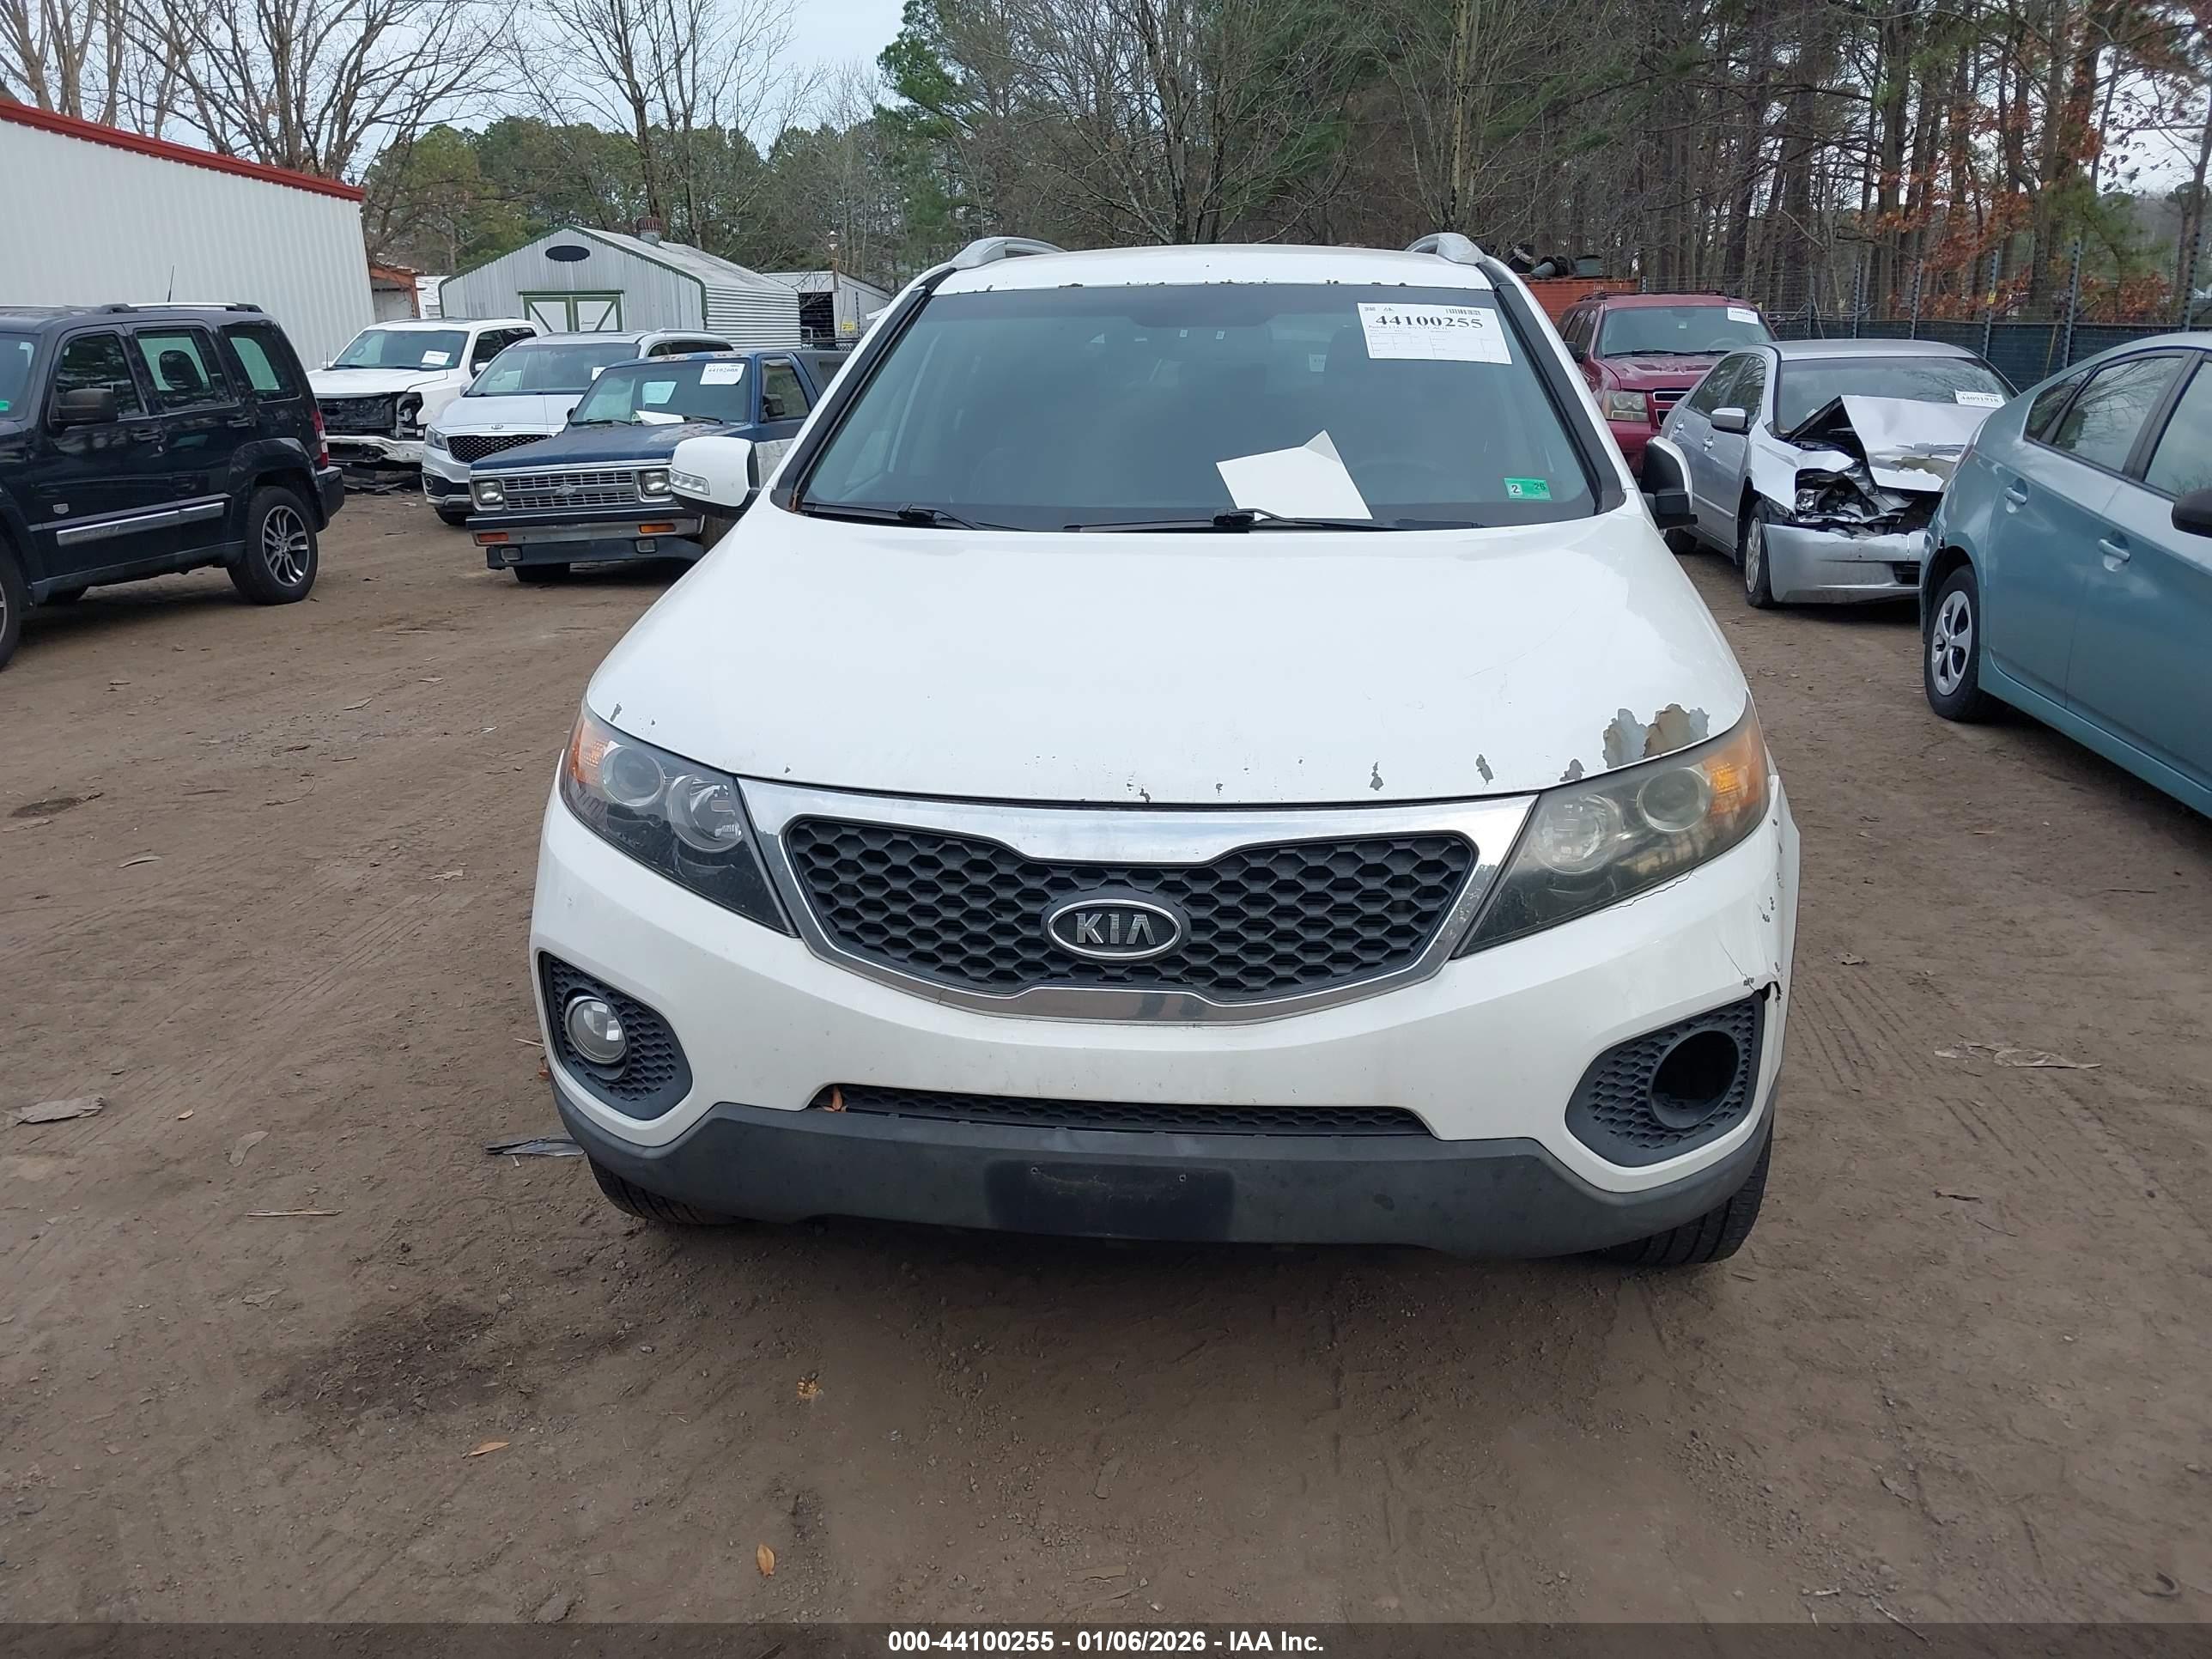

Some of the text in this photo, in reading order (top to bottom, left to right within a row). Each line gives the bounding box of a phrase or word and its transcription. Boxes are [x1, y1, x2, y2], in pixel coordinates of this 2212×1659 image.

[1376, 315, 1483, 329] 44100255
[1511, 484, 1521, 494] 2
[1075, 913, 1156, 945] KIA
